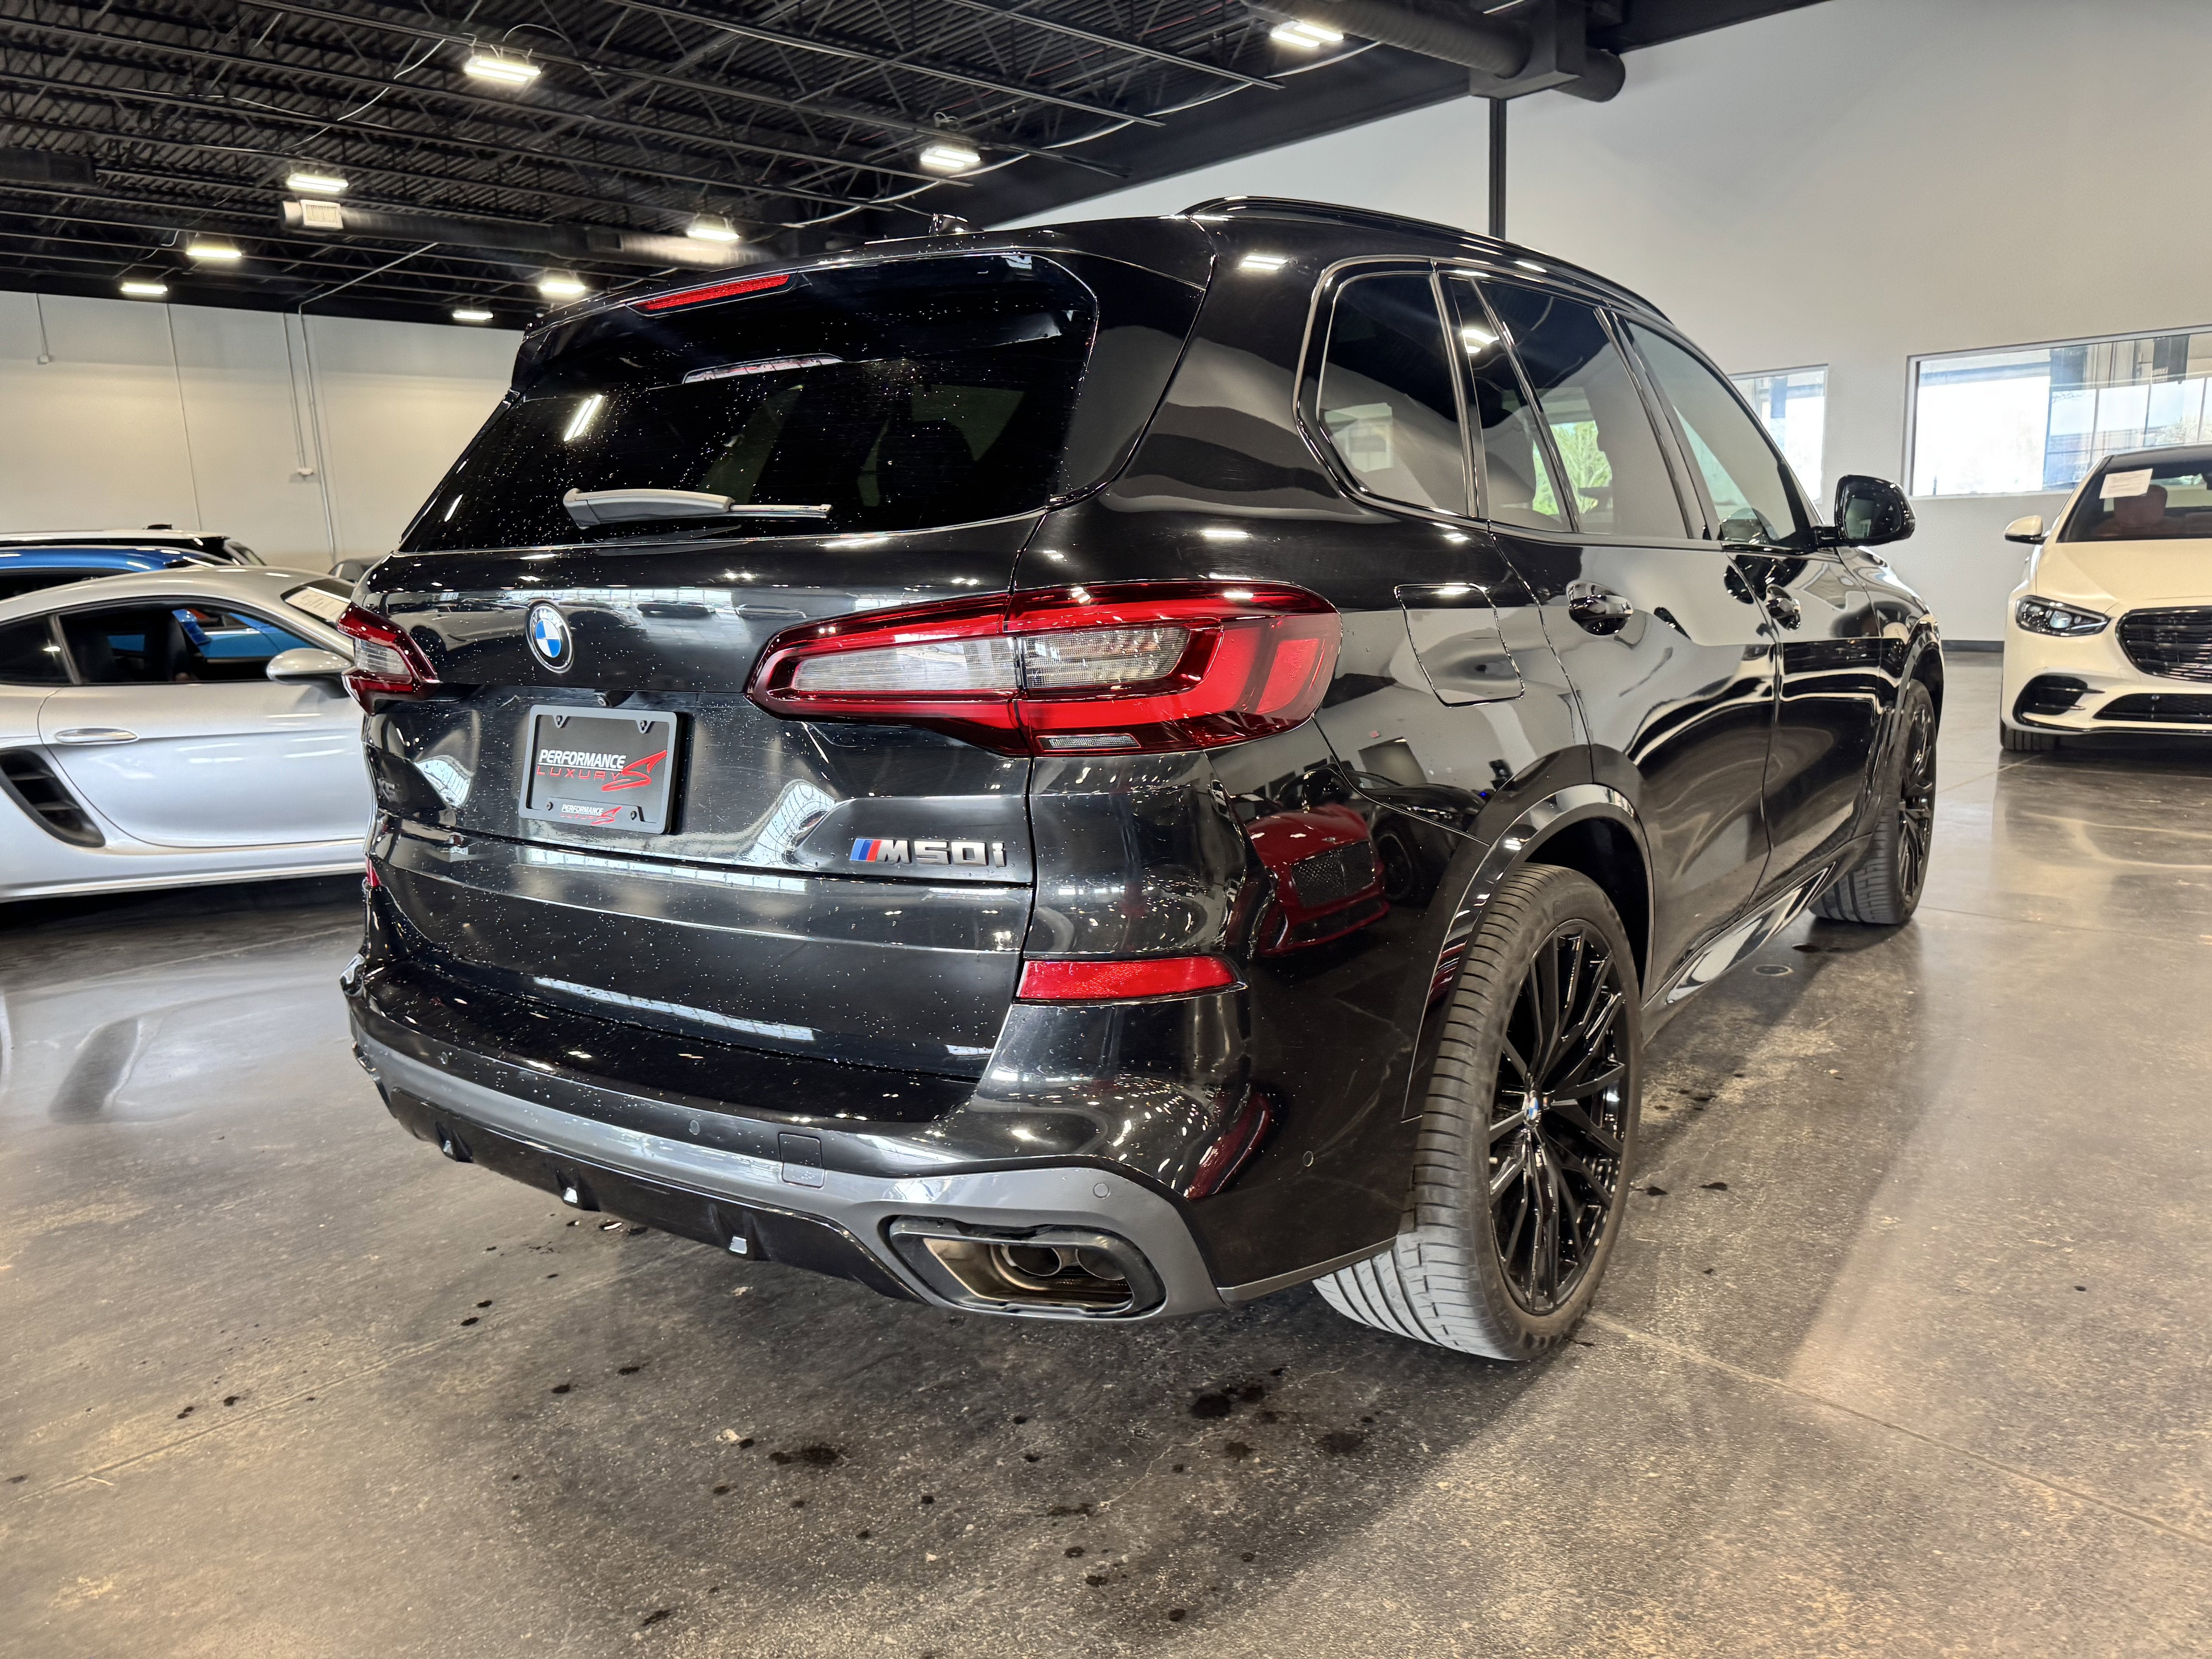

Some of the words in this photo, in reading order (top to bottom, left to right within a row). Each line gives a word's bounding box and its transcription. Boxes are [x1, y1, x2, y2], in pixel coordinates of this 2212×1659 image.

[539, 749, 626, 768] PERFORMANCE
[562, 804, 603, 814] PERFORMANCE
[875, 840, 1006, 868] M50i
